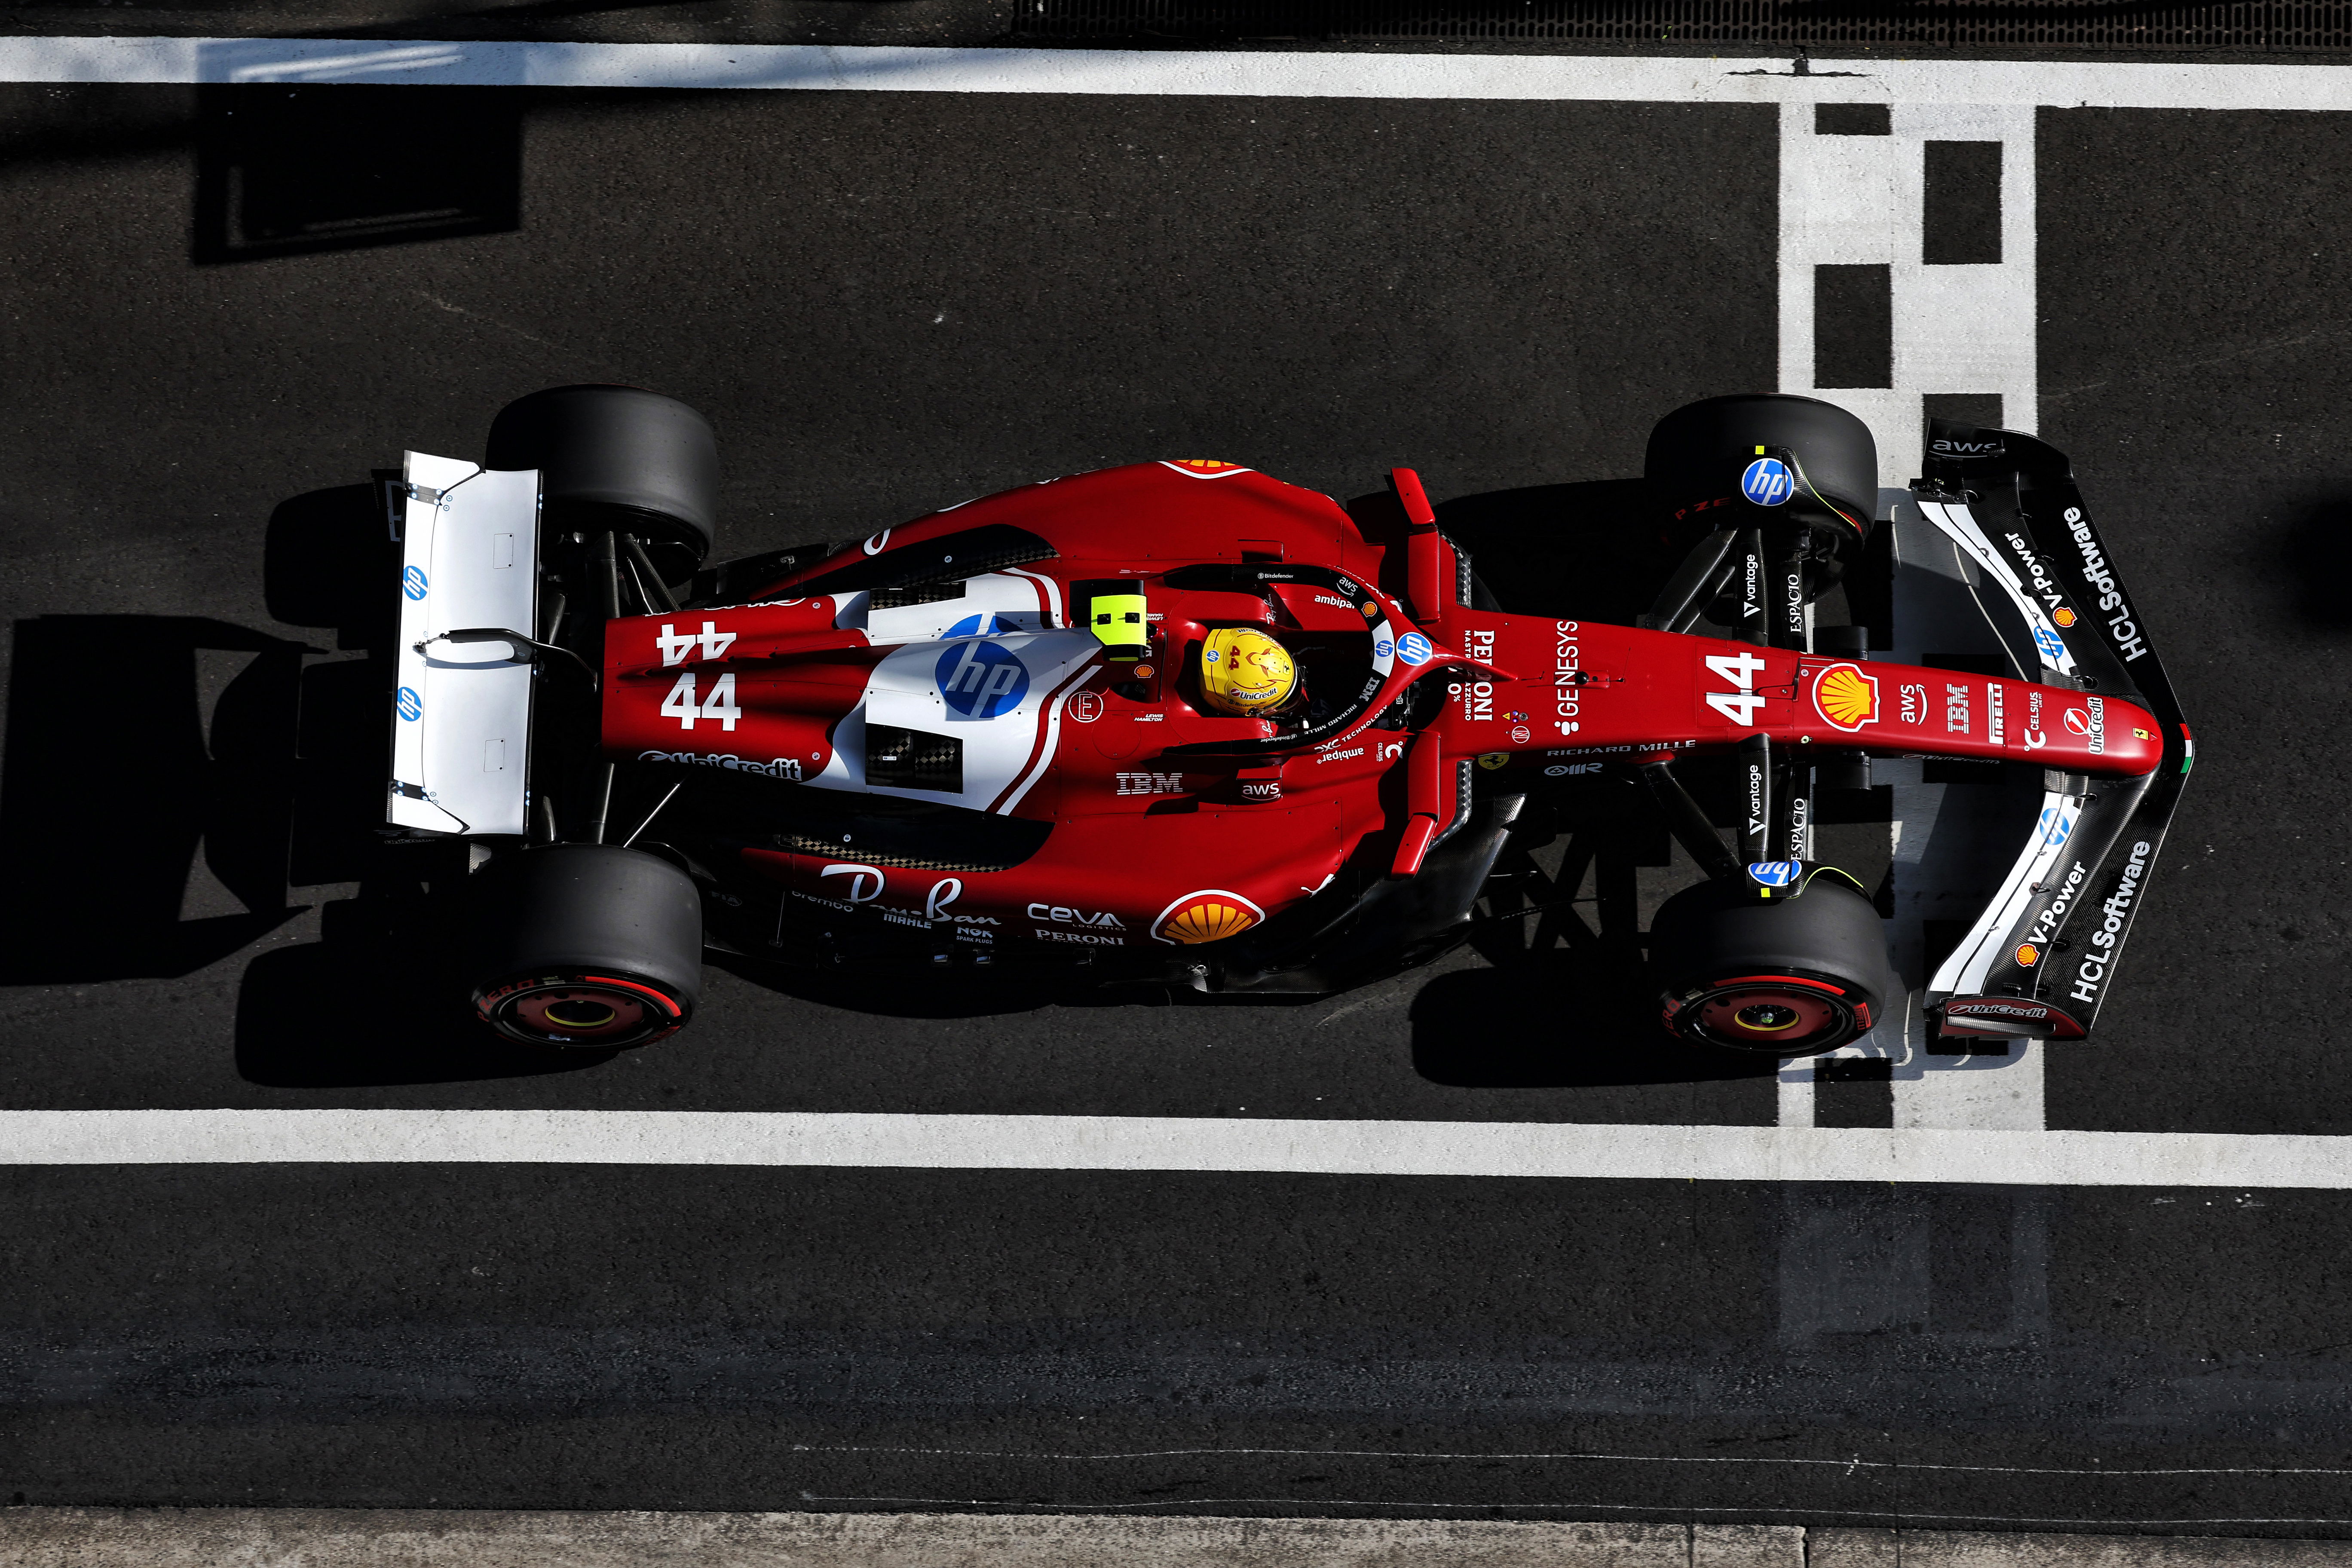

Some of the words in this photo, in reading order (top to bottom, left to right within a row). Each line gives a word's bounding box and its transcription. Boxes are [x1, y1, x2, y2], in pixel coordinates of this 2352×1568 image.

[1748, 459, 1789, 505] hp
[403, 566, 427, 599] hp
[1339, 577, 1358, 592] aws
[1744, 554, 1758, 600] vantage
[2004, 532, 2063, 609] V-Power
[2064, 507, 2147, 662] HCLSoftware
[1787, 573, 1801, 633] ESPACIO
[656, 621, 737, 667] 44
[1206, 650, 1220, 662] hp
[1228, 645, 1241, 671] 44
[1375, 641, 1393, 656] hp
[1398, 634, 1431, 663] hp
[944, 641, 1022, 718] hp
[1473, 630, 1495, 721] PEONI
[1554, 620, 1579, 717] GENESYS
[397, 688, 421, 721] hp
[661, 673, 741, 731] 44
[1240, 687, 1277, 700] UniCredit
[1359, 677, 1380, 701] IBM
[1706, 652, 1766, 726] 44
[1901, 684, 1915, 723] aws
[1328, 703, 1357, 726] RICHARD
[1341, 704, 1388, 742] TECHNOLOGY
[1947, 683, 1969, 734] IBM
[1988, 683, 2004, 744] PIRELLI
[1304, 724, 1327, 735] MILLE
[2087, 697, 2104, 754] UniCredit
[1547, 746, 1631, 756] RICHARD
[1639, 739, 1696, 751] MILLE
[1116, 772, 1183, 795] IBM
[1242, 783, 1280, 796] aws
[1749, 765, 1762, 817] vantage
[1791, 798, 1806, 860] ESPACIO
[1754, 860, 1794, 885] hp
[792, 890, 854, 913] brembo
[2028, 861, 2087, 944] V-Power
[883, 913, 932, 930] MAHLE
[957, 926, 993, 938] NGK
[1035, 929, 1125, 945] PERONI
[2070, 841, 2150, 1003] HCLSoftware
[479, 978, 535, 1011] ZERO
[1969, 1005, 2046, 1017] UniCredit
